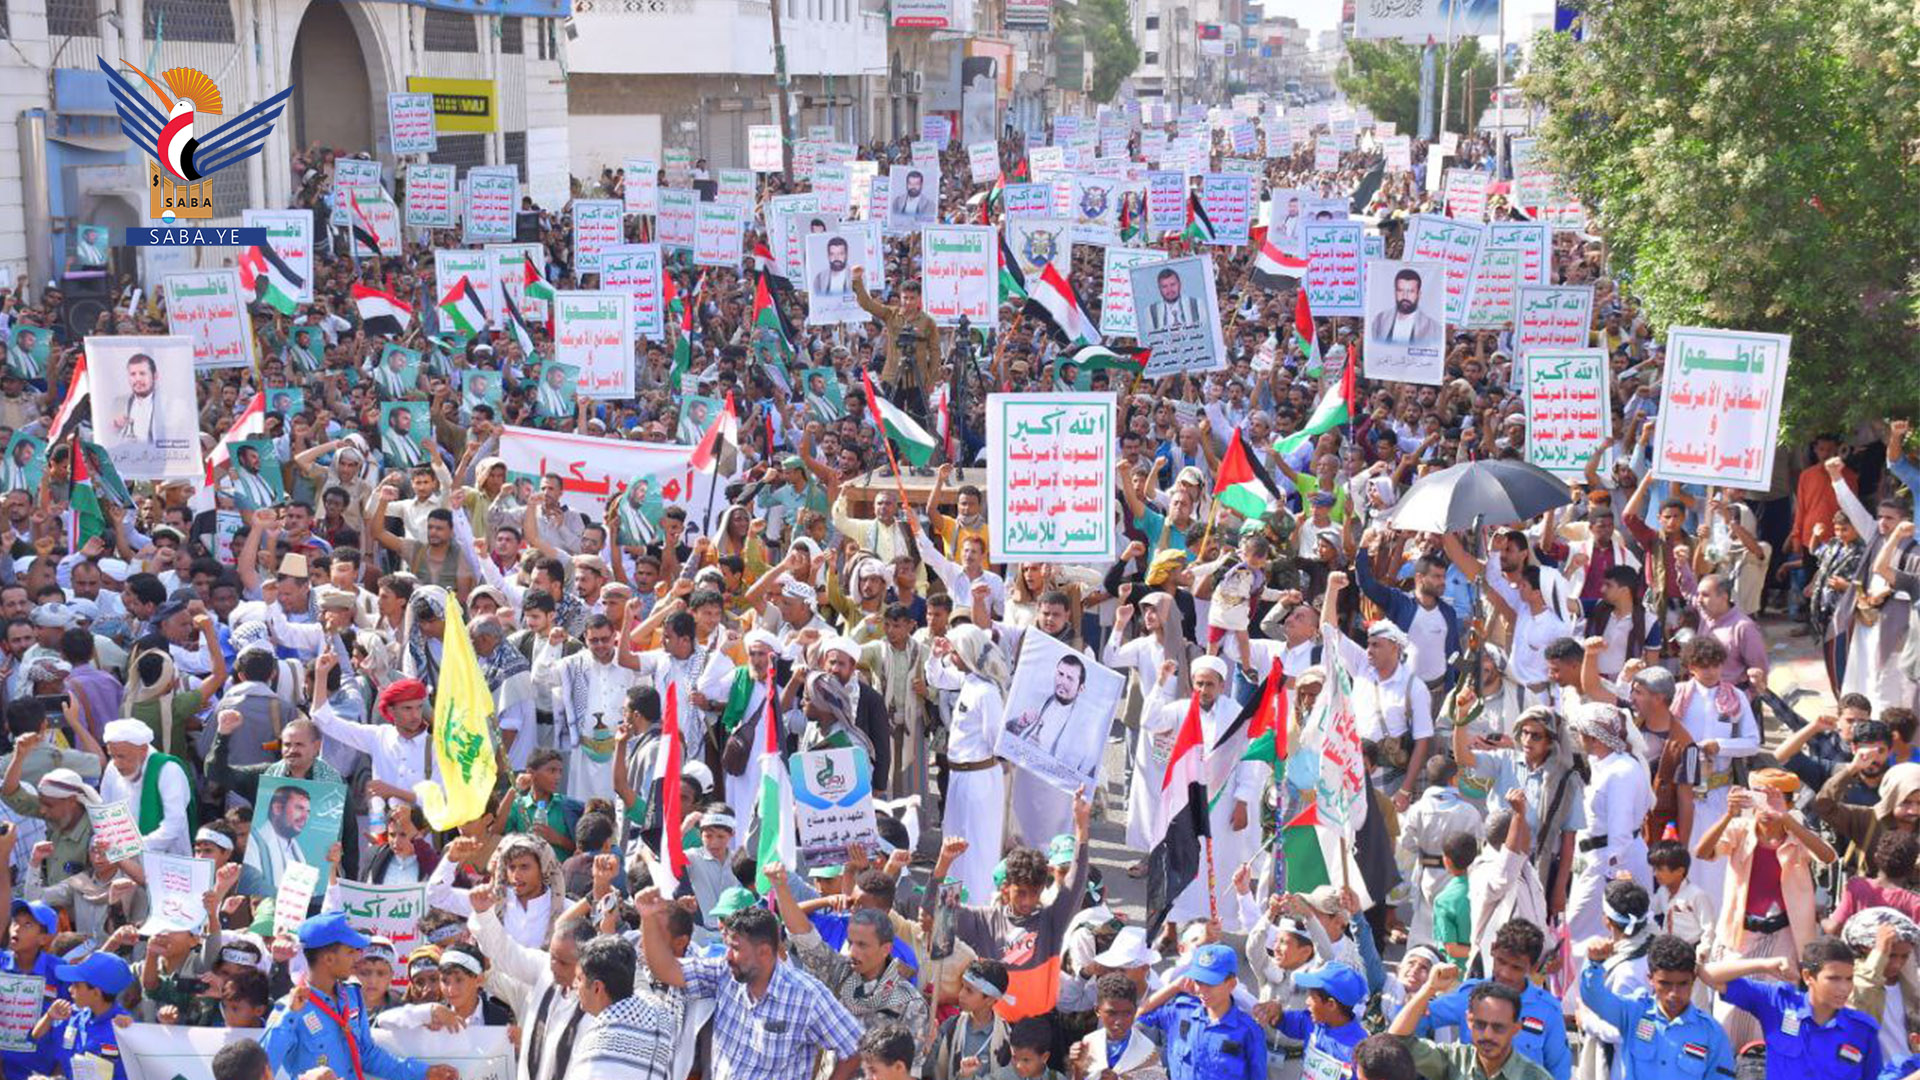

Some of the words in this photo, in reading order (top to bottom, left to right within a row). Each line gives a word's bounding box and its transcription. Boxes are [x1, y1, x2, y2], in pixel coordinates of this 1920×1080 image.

[929, 234, 982, 256] قاطعوا
[443, 256, 486, 274] قاطعوا
[636, 257, 653, 270] الله
[960, 263, 987, 279] البضائع
[170, 276, 229, 302] قاطعوا
[633, 276, 652, 285] الموت
[954, 281, 959, 295] و
[634, 291, 653, 299] الموت
[1562, 294, 1585, 309] الله
[208, 304, 236, 322] البضائع
[561, 299, 617, 324] قاطعوا
[637, 304, 656, 312] اللعنة
[203, 322, 209, 338] و
[634, 313, 656, 331] النصر
[1556, 316, 1583, 328] الموت
[595, 332, 622, 349] البضائع
[1554, 332, 1581, 345] الموت
[587, 350, 592, 366] و
[1679, 341, 1765, 375] قاطعوا
[1574, 362, 1599, 379] الله
[1570, 387, 1600, 402] الموت
[1670, 380, 1722, 410] الأمريكية
[1723, 386, 1769, 413] البضائع
[1008, 407, 1066, 441] أكبر
[1068, 410, 1105, 435] الله
[1572, 408, 1600, 422] الموت
[1533, 427, 1558, 441] اليهود
[1561, 427, 1574, 441] على
[1579, 427, 1601, 440] اللعنة
[1709, 414, 1718, 436] و
[1009, 443, 1059, 464] لأمريكا
[1062, 445, 1103, 464] الموت
[1665, 440, 1762, 475] الإسرائيلية
[1009, 470, 1058, 491] لإسرائيل
[1062, 472, 1103, 490] الموت
[1008, 497, 1043, 516] اليهود
[1047, 497, 1066, 516] على
[1072, 496, 1102, 512] اللعنة
[1008, 520, 1056, 548] للإسلام
[1060, 518, 1102, 547] النصر
[827, 815, 837, 823] هم
[841, 830, 850, 841] في
[388, 897, 420, 919] الله
